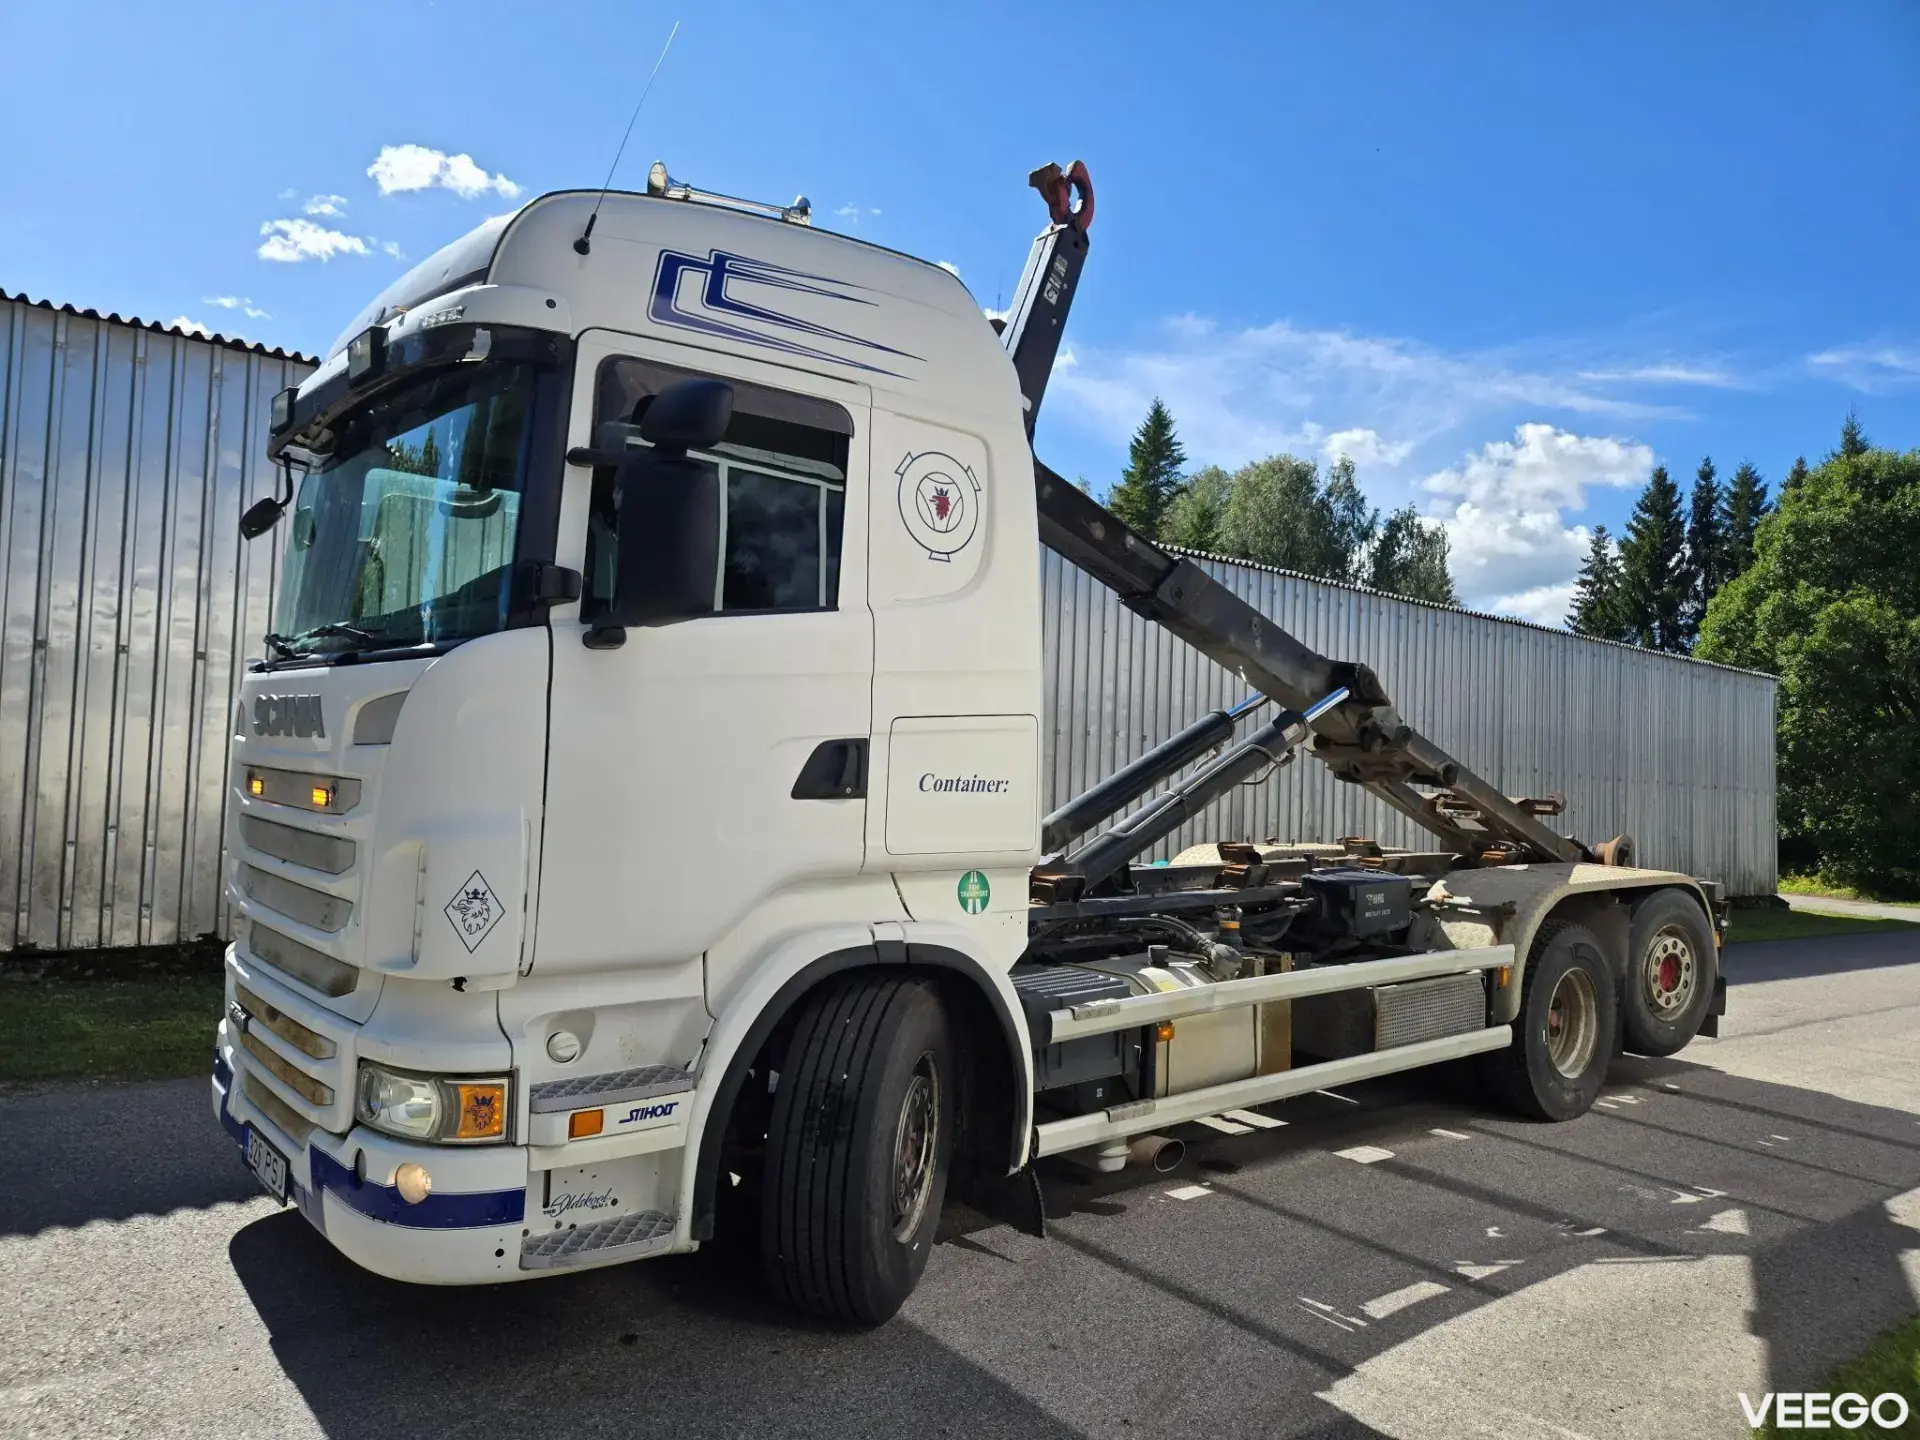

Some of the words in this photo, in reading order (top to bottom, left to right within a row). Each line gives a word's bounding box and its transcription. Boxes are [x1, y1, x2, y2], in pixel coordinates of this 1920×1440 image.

[253, 694, 325, 738] SCANIA
[919, 773, 1010, 793] Container:
[263, 1151, 285, 1191] PSJ
